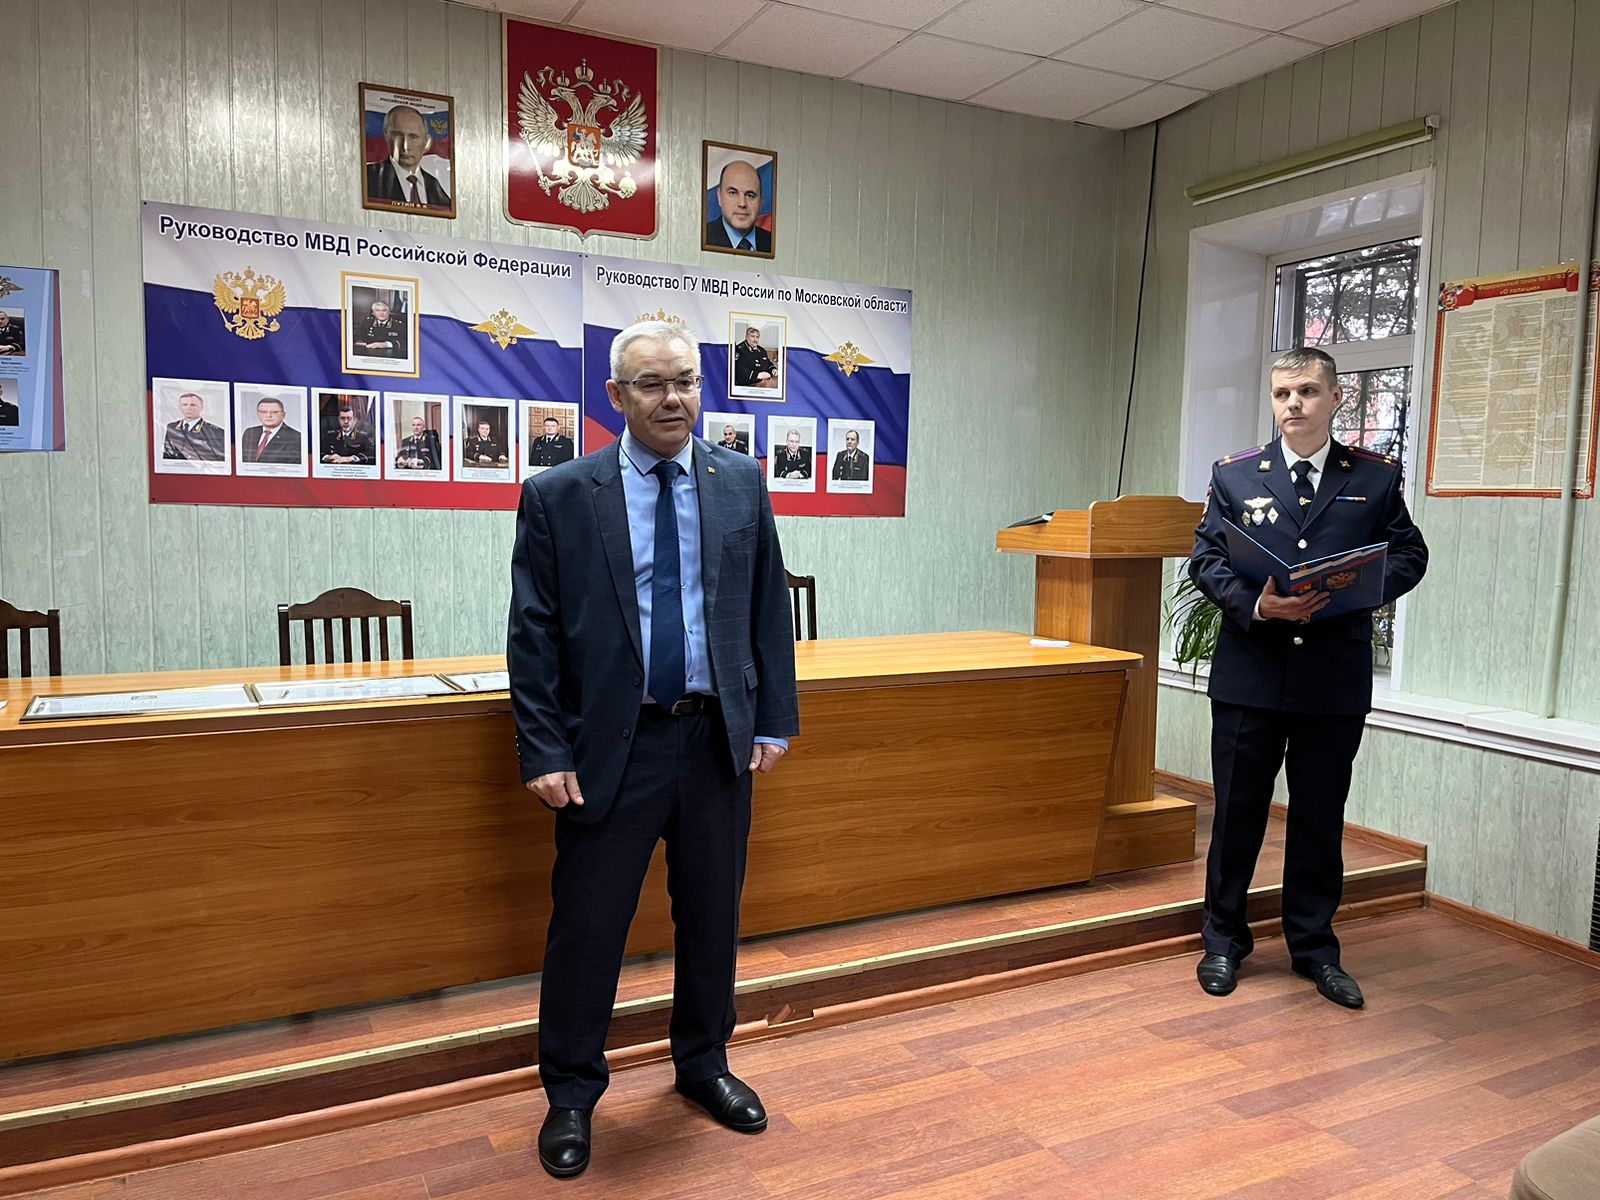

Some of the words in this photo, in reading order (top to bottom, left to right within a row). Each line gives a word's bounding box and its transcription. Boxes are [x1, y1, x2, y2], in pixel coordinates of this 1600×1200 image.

[159, 215, 299, 247] Руководство
[305, 232, 350, 256] МВД
[356, 238, 467, 266] Российской
[473, 252, 571, 278] Федерации
[596, 266, 680, 290] Руководство
[683, 276, 698, 292] ГУ
[702, 278, 728, 298] МВД
[732, 282, 774, 300] России
[778, 289, 792, 301] по
[795, 288, 861, 308] Московской
[864, 296, 907, 314] области
